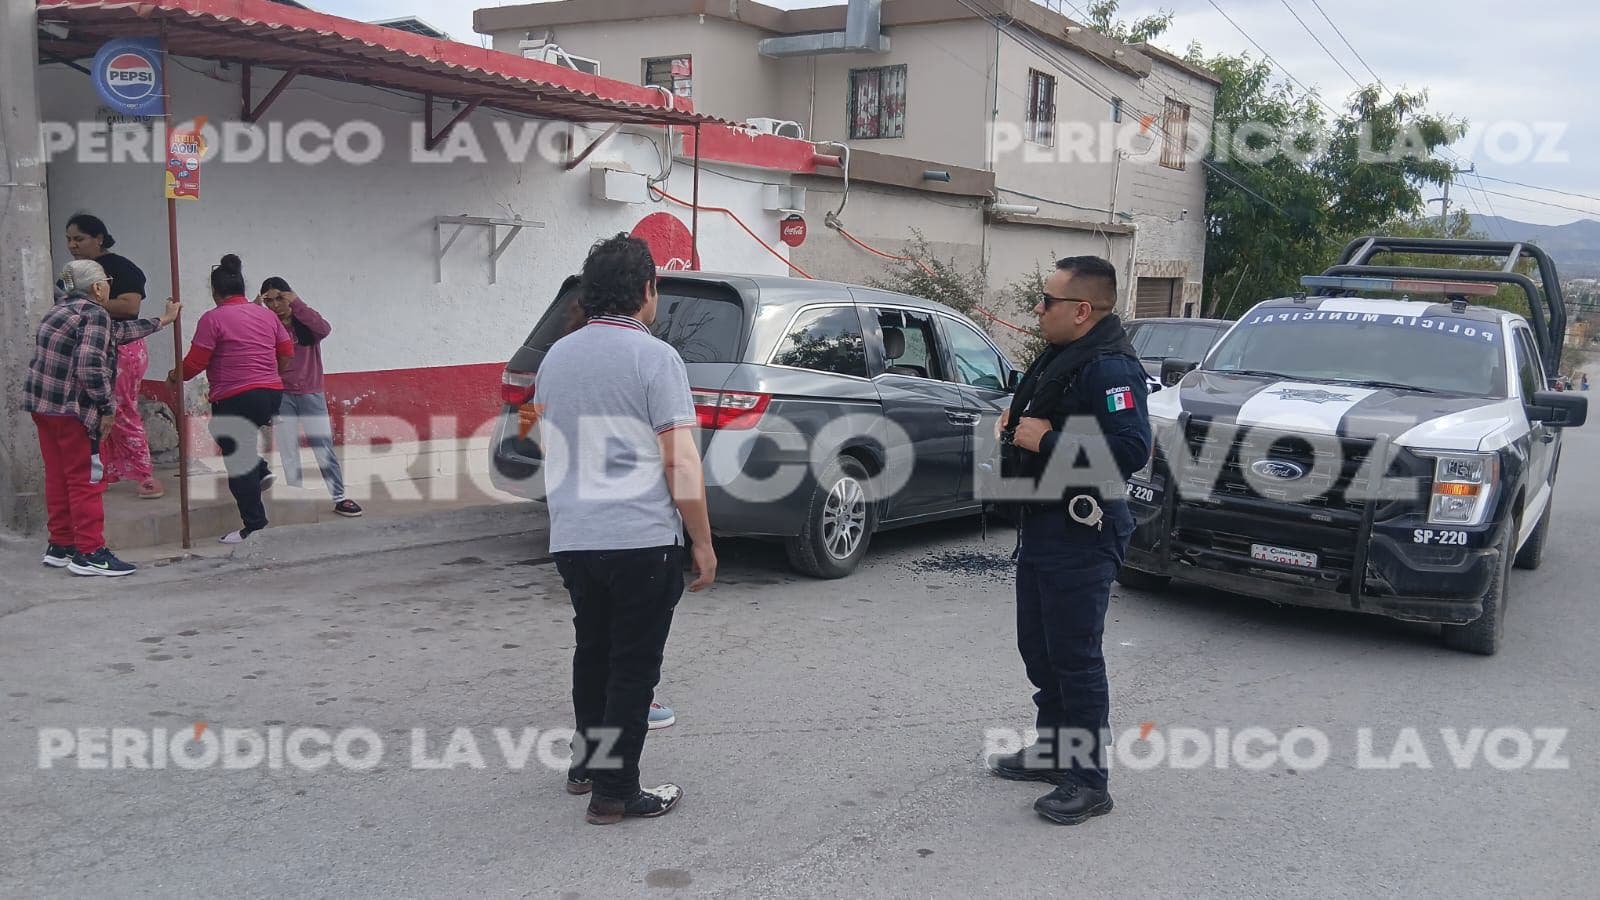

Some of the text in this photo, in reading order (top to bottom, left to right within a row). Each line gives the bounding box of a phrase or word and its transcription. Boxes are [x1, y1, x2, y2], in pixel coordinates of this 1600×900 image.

[110, 71, 153, 82] PEPSI
[1262, 463, 1291, 477] Ford
[1126, 483, 1154, 502] P-220
[1413, 529, 1467, 546] SP-220
